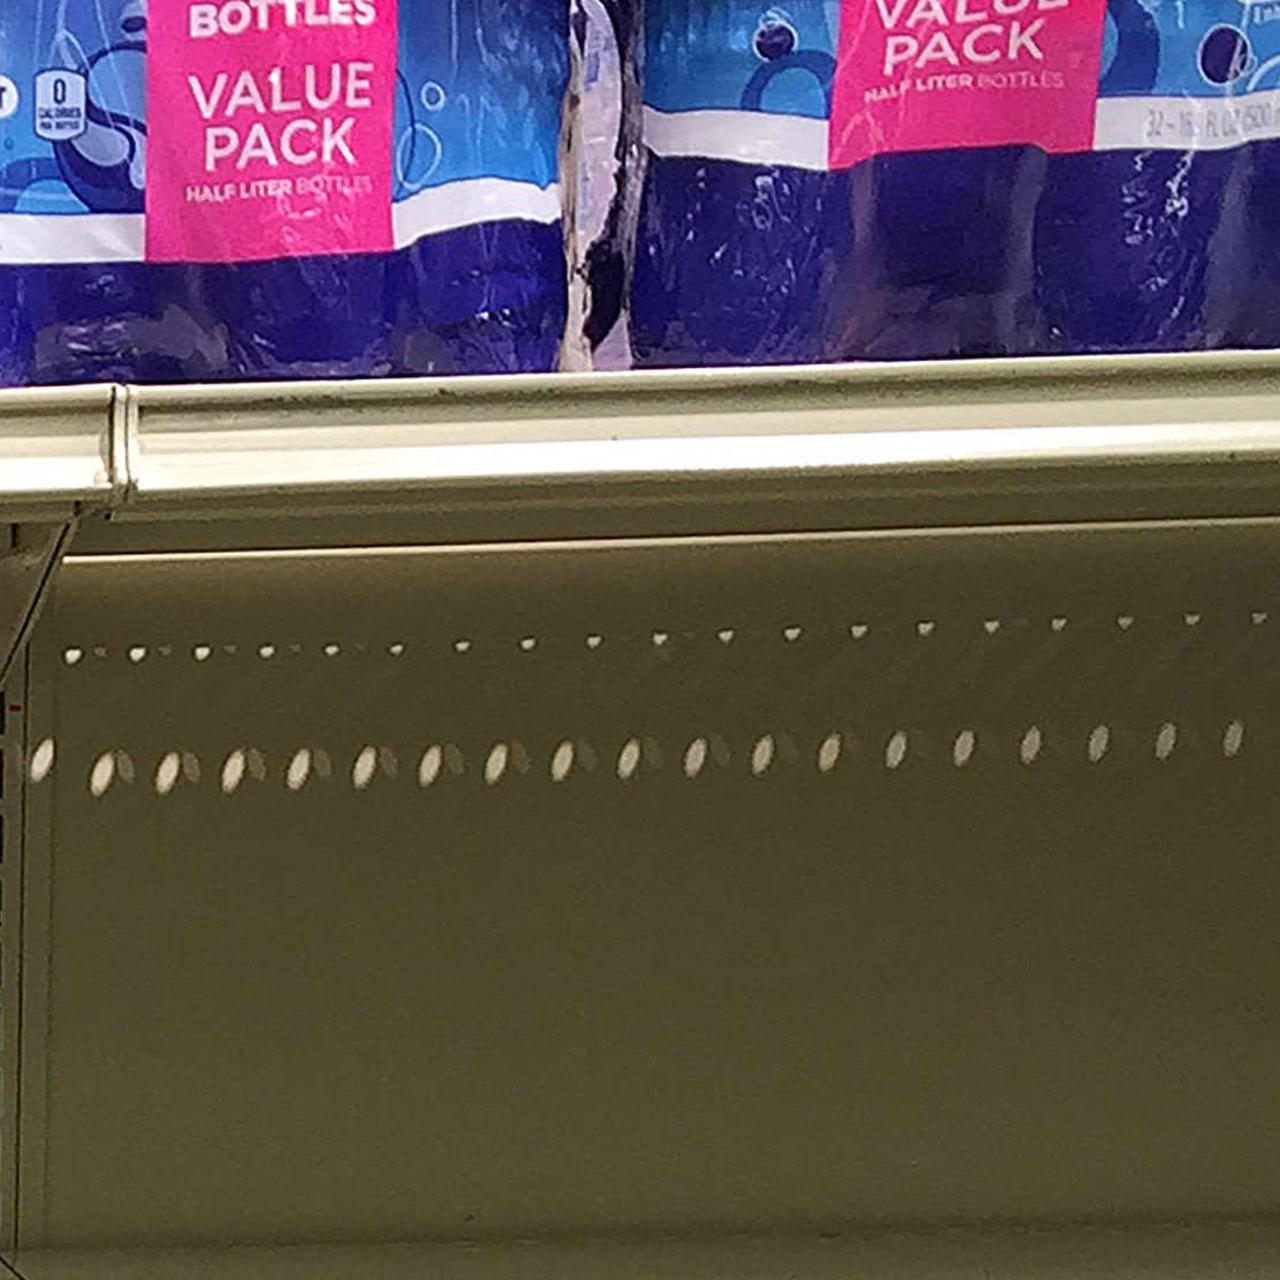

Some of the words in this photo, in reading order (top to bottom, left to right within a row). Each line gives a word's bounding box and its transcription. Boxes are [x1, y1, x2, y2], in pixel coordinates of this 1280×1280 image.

[190, 0, 376, 38] BOTTLES
[875, 0, 1069, 29] VAL
[883, 18, 1046, 77] PACK
[53, 78, 67, 104] 0
[188, 61, 375, 119] VALUE
[864, 81, 911, 104] HALF
[915, 72, 974, 92] LITER
[976, 70, 1065, 89] BOTTLES
[205, 117, 356, 172] PACK
[186, 183, 235, 202] HALF
[239, 178, 292, 199] LITER
[296, 174, 372, 196] BOTTLES
